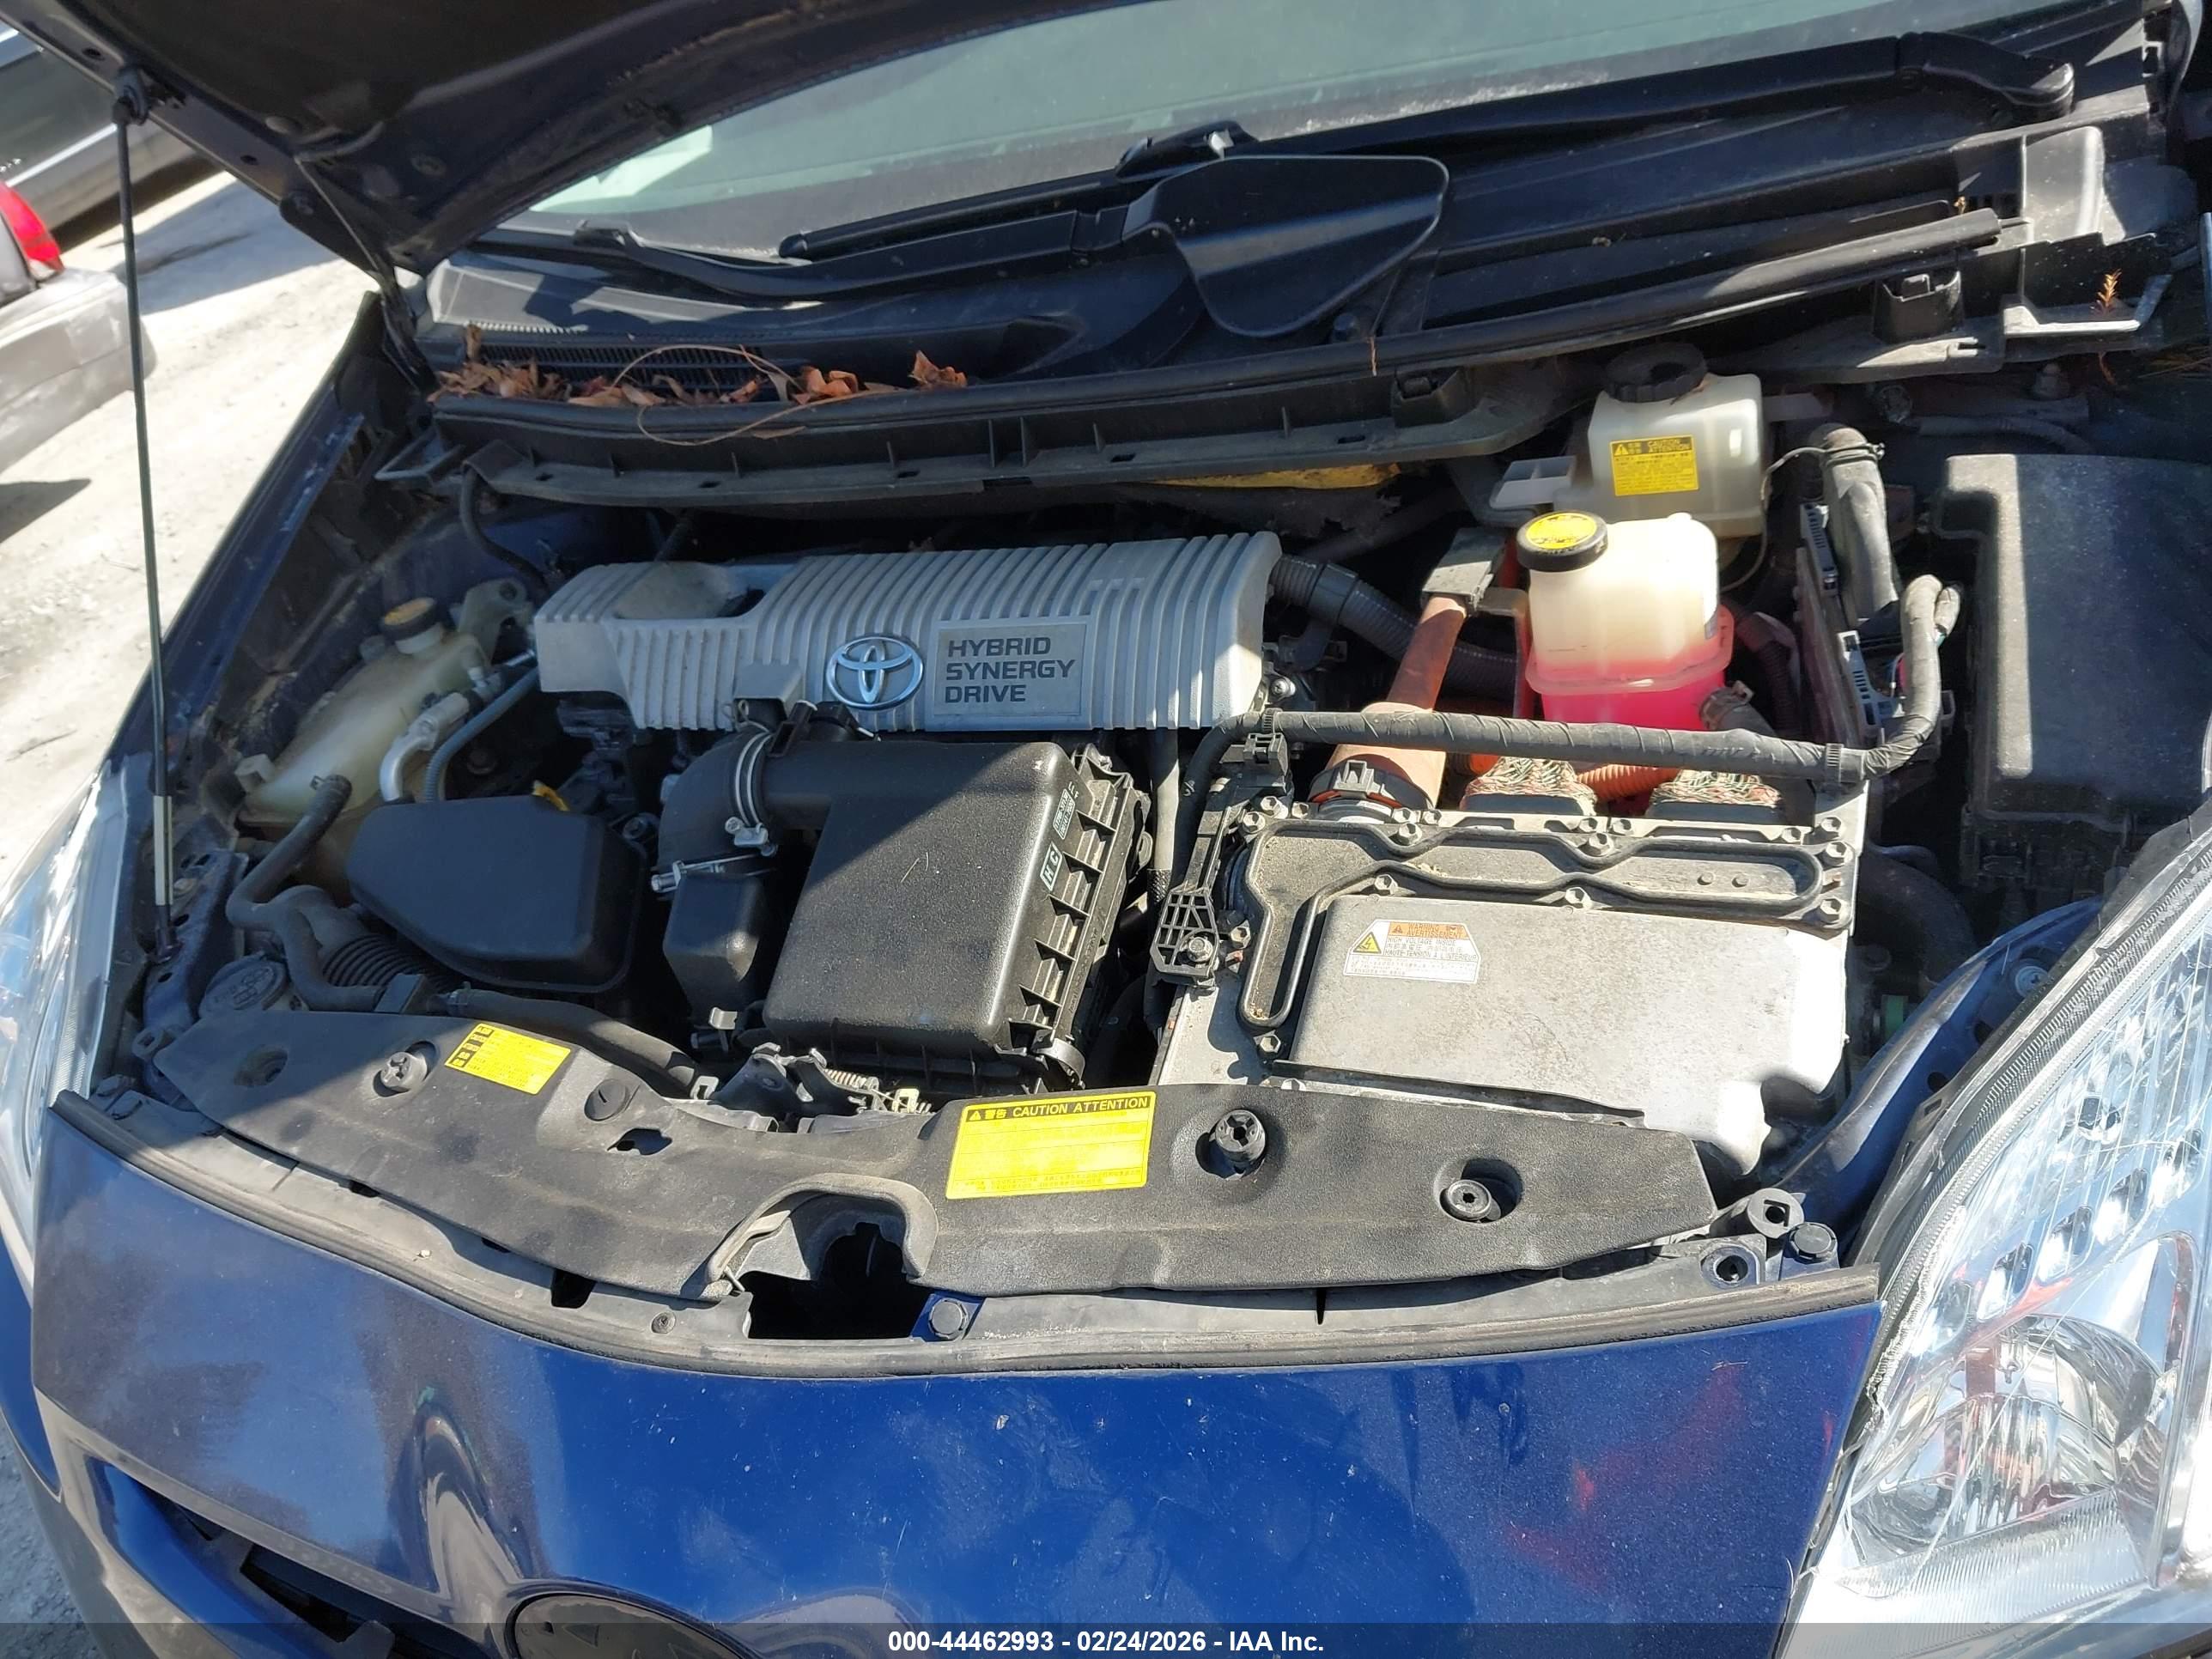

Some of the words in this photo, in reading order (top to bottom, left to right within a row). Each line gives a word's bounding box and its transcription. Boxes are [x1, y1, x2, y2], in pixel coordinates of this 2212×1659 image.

[948, 637, 1051, 657] HYBRID
[946, 659, 1075, 680] SYNERGY
[945, 684, 1026, 703] DRIVE
[1407, 929, 1462, 939] AVERTISSEMENT
[1408, 922, 1439, 932] WARNING
[1013, 1103, 1067, 1118] CAUTION
[1073, 1097, 1147, 1114] ATTENTION
